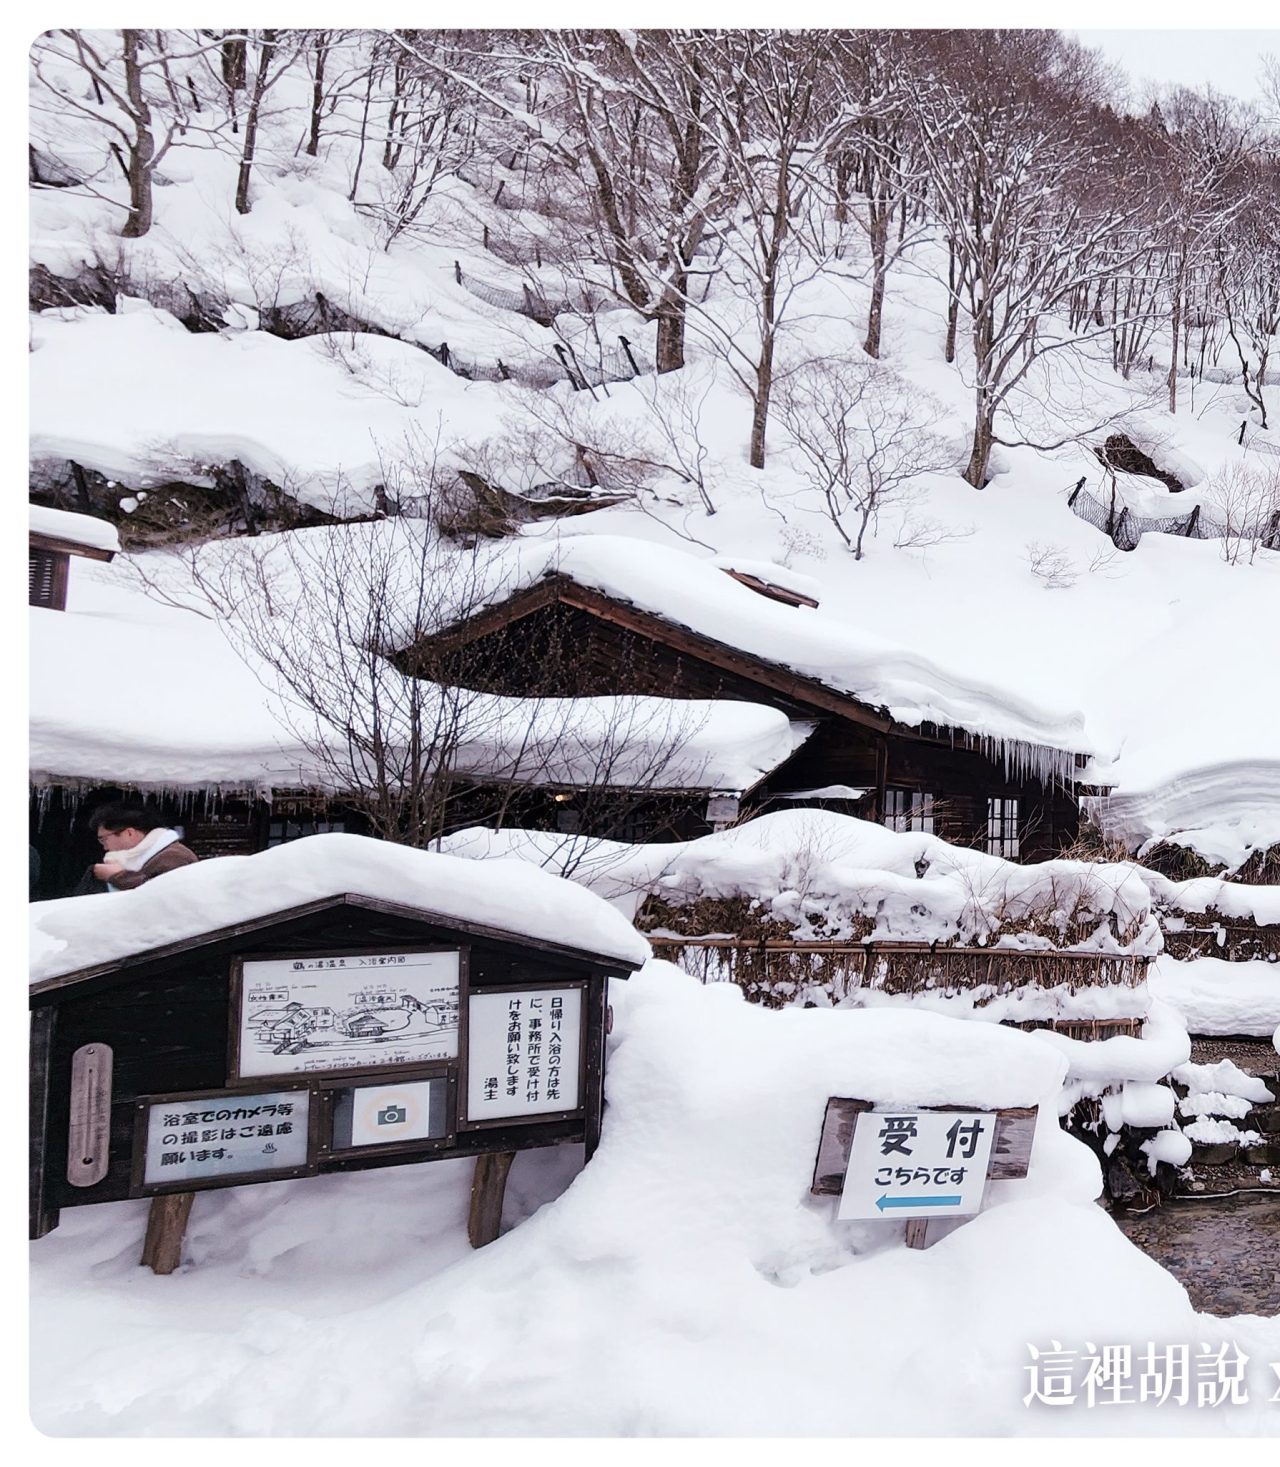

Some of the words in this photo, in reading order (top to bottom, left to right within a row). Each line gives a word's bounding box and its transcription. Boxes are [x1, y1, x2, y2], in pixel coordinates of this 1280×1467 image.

[506, 999, 522, 1096] けをお願い致します
[526, 998, 543, 1102] に、事務所で受け付
[546, 997, 563, 1100] 日帰り入浴の方は先
[483, 1077, 499, 1101] 湯主
[163, 1103, 294, 1127] 浴室でのカメラ等
[162, 1122, 293, 1145] の撮影はご遠慮
[160, 1147, 233, 1166] 願います。
[874, 1166, 968, 1186] こちらです
